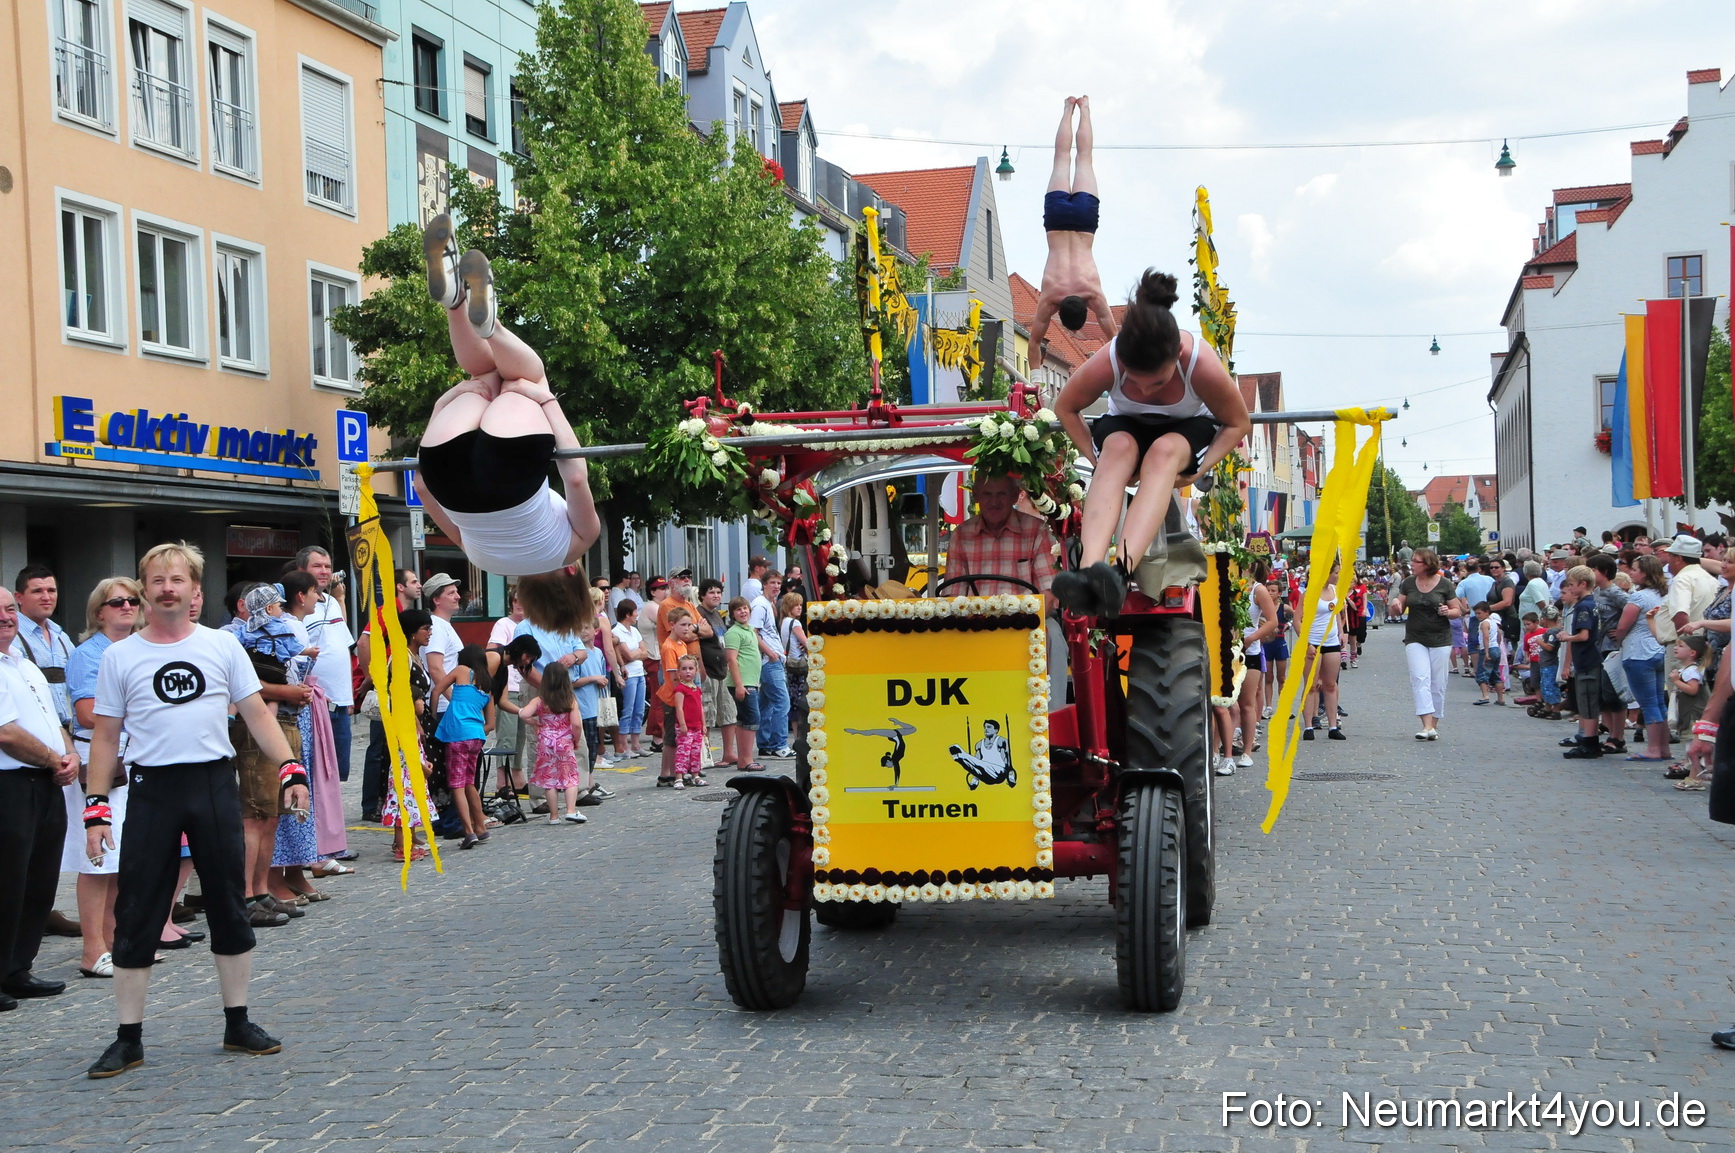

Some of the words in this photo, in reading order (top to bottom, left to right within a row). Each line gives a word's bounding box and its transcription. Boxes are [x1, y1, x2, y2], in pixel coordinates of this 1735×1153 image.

[53, 395, 95, 443] E
[99, 408, 210, 455] aktiv
[210, 425, 318, 467] markt
[344, 417, 361, 455] P
[62, 445, 93, 457] EDEKA
[238, 532, 265, 554] Super
[163, 672, 195, 698] DJK
[886, 677, 970, 707] DJK
[882, 799, 978, 819] Turnen
